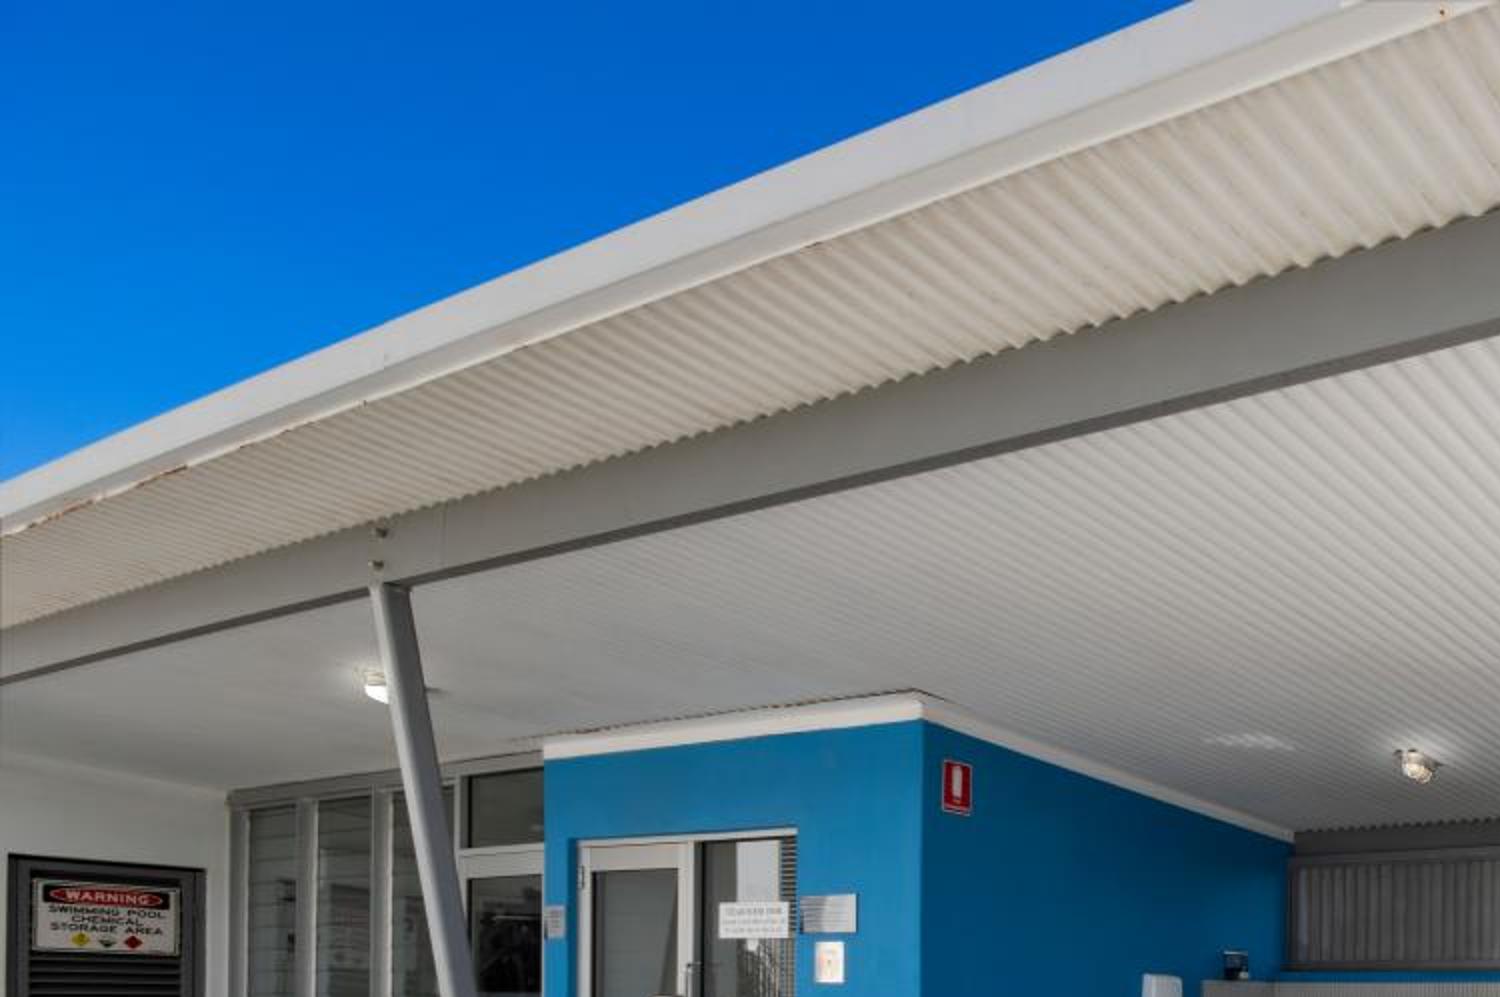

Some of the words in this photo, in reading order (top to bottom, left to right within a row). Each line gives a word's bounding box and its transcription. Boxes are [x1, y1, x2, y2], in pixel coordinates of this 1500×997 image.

[65, 889, 150, 905] WARNING
[49, 904, 119, 916] SWIMMING
[127, 908, 166, 919] POOL
[72, 915, 143, 927] CHEMICAL
[50, 922, 118, 933] STORAGE
[125, 926, 163, 935] AREA
